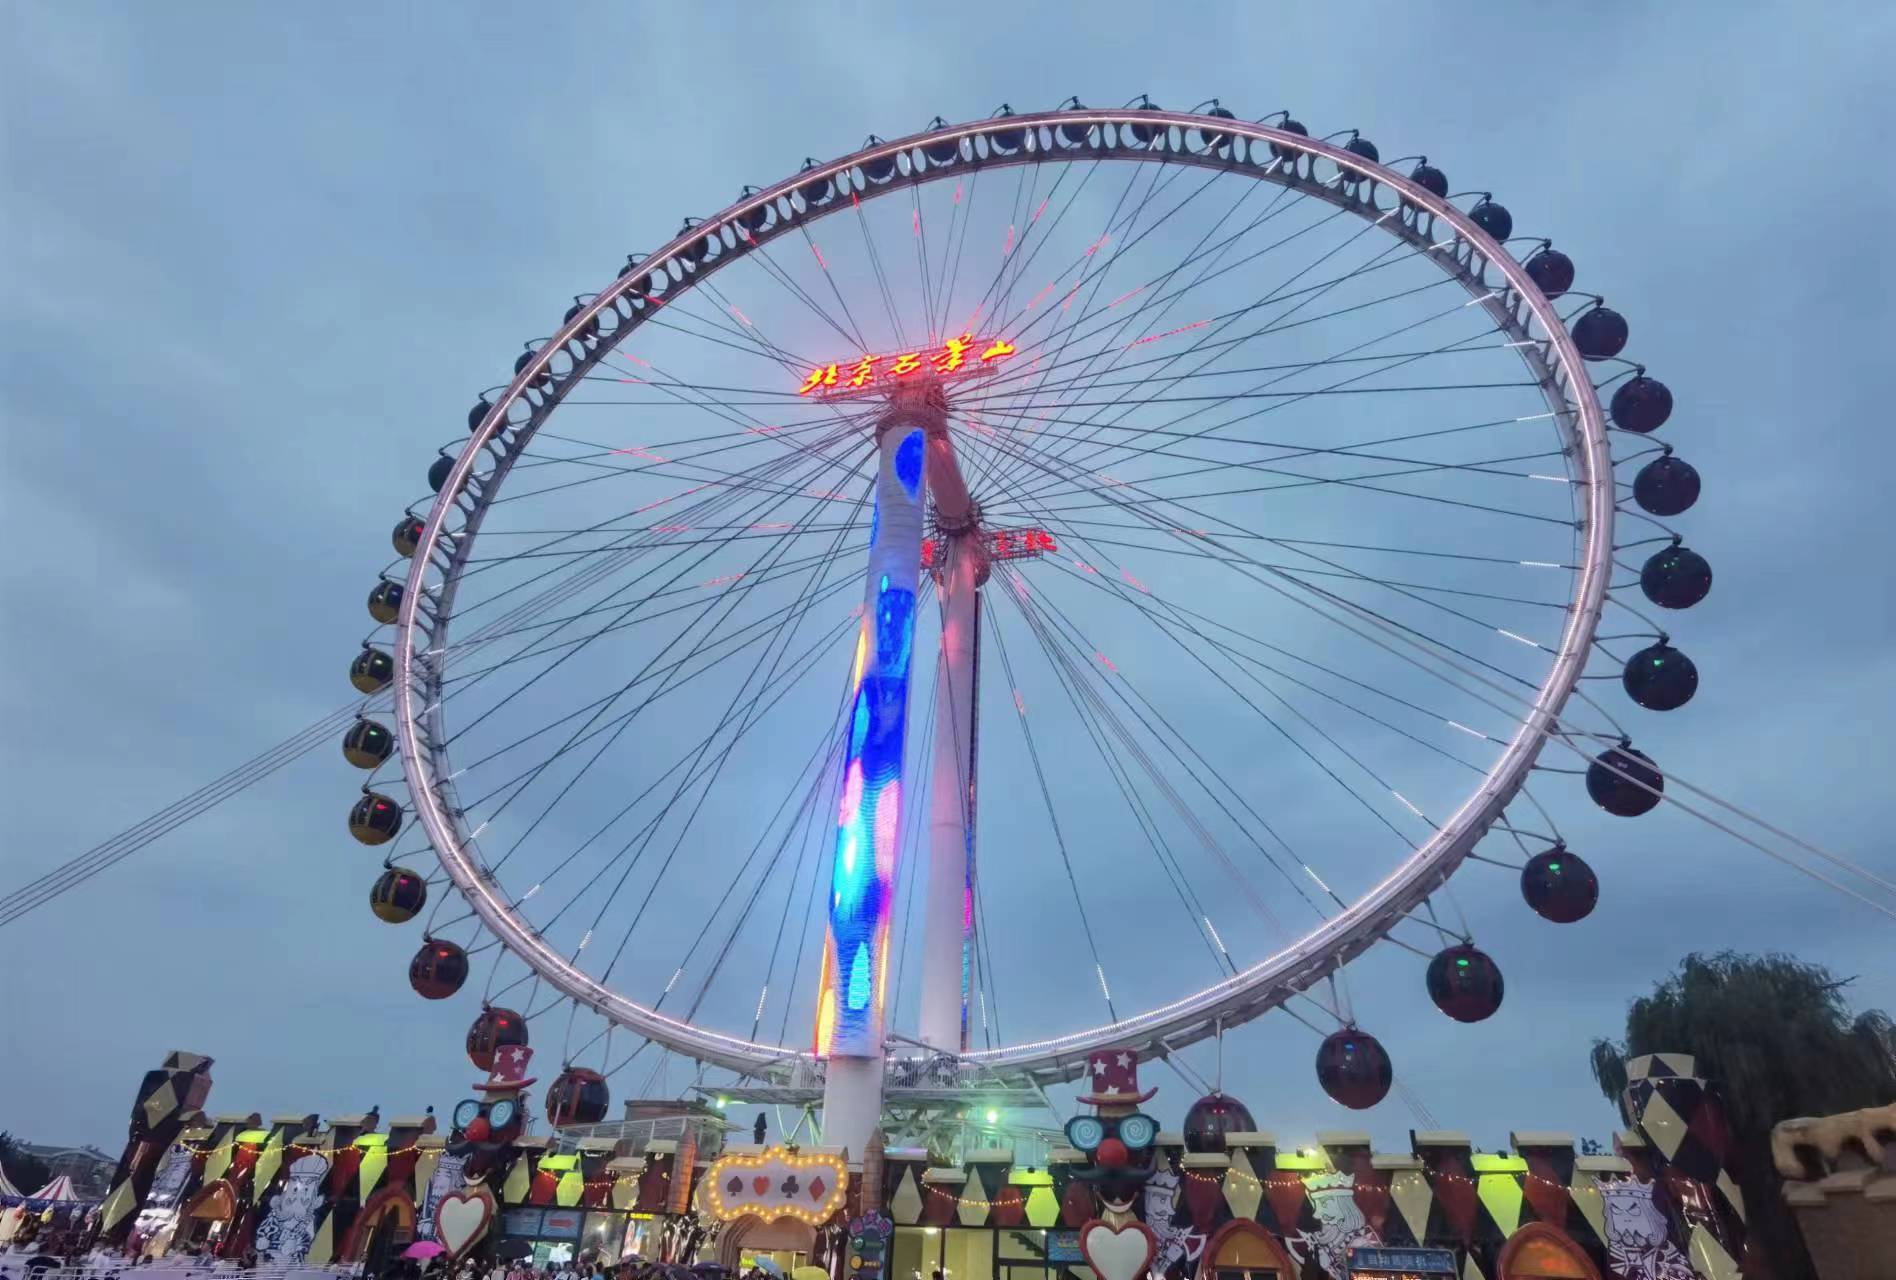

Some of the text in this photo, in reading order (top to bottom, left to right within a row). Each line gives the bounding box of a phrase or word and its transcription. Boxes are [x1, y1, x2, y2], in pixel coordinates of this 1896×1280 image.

[798, 333, 1016, 395] 北京石景山
